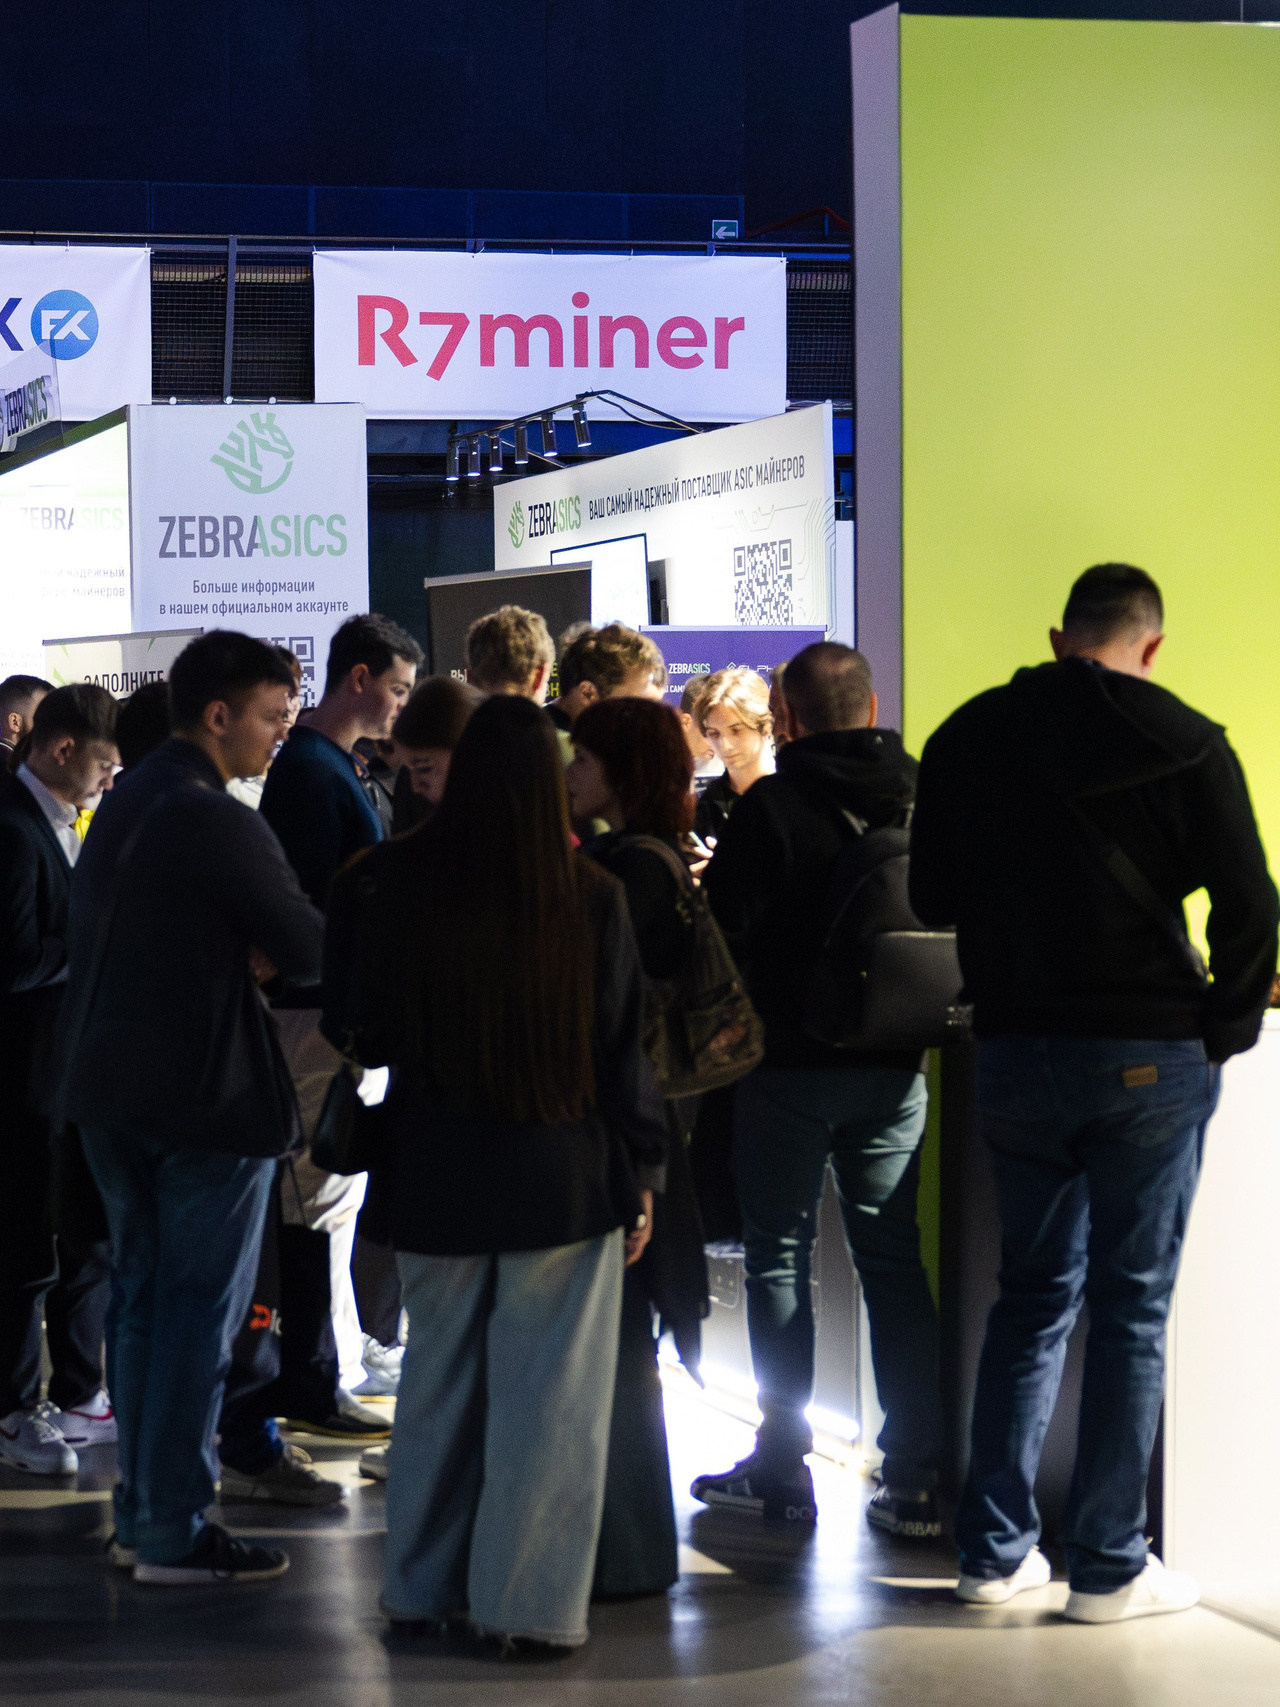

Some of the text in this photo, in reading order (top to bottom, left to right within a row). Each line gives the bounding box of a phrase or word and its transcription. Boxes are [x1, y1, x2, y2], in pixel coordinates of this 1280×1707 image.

[356, 290, 746, 383] R7miner
[4, 375, 49, 437] ZEBRASICS
[589, 455, 805, 521] ВАШ САМЫЙ НАДЕЖНЫЙ ПОСТАВЩИК ASIC МАЙНЕРОВ
[158, 513, 348, 559] ZEBRASICS
[527, 495, 582, 538] ZEBRASICS
[159, 600, 349, 617] в нашем официальном аккаунте
[193, 579, 315, 599] Больше информации
[668, 663, 711, 674] ZEBRASICS
